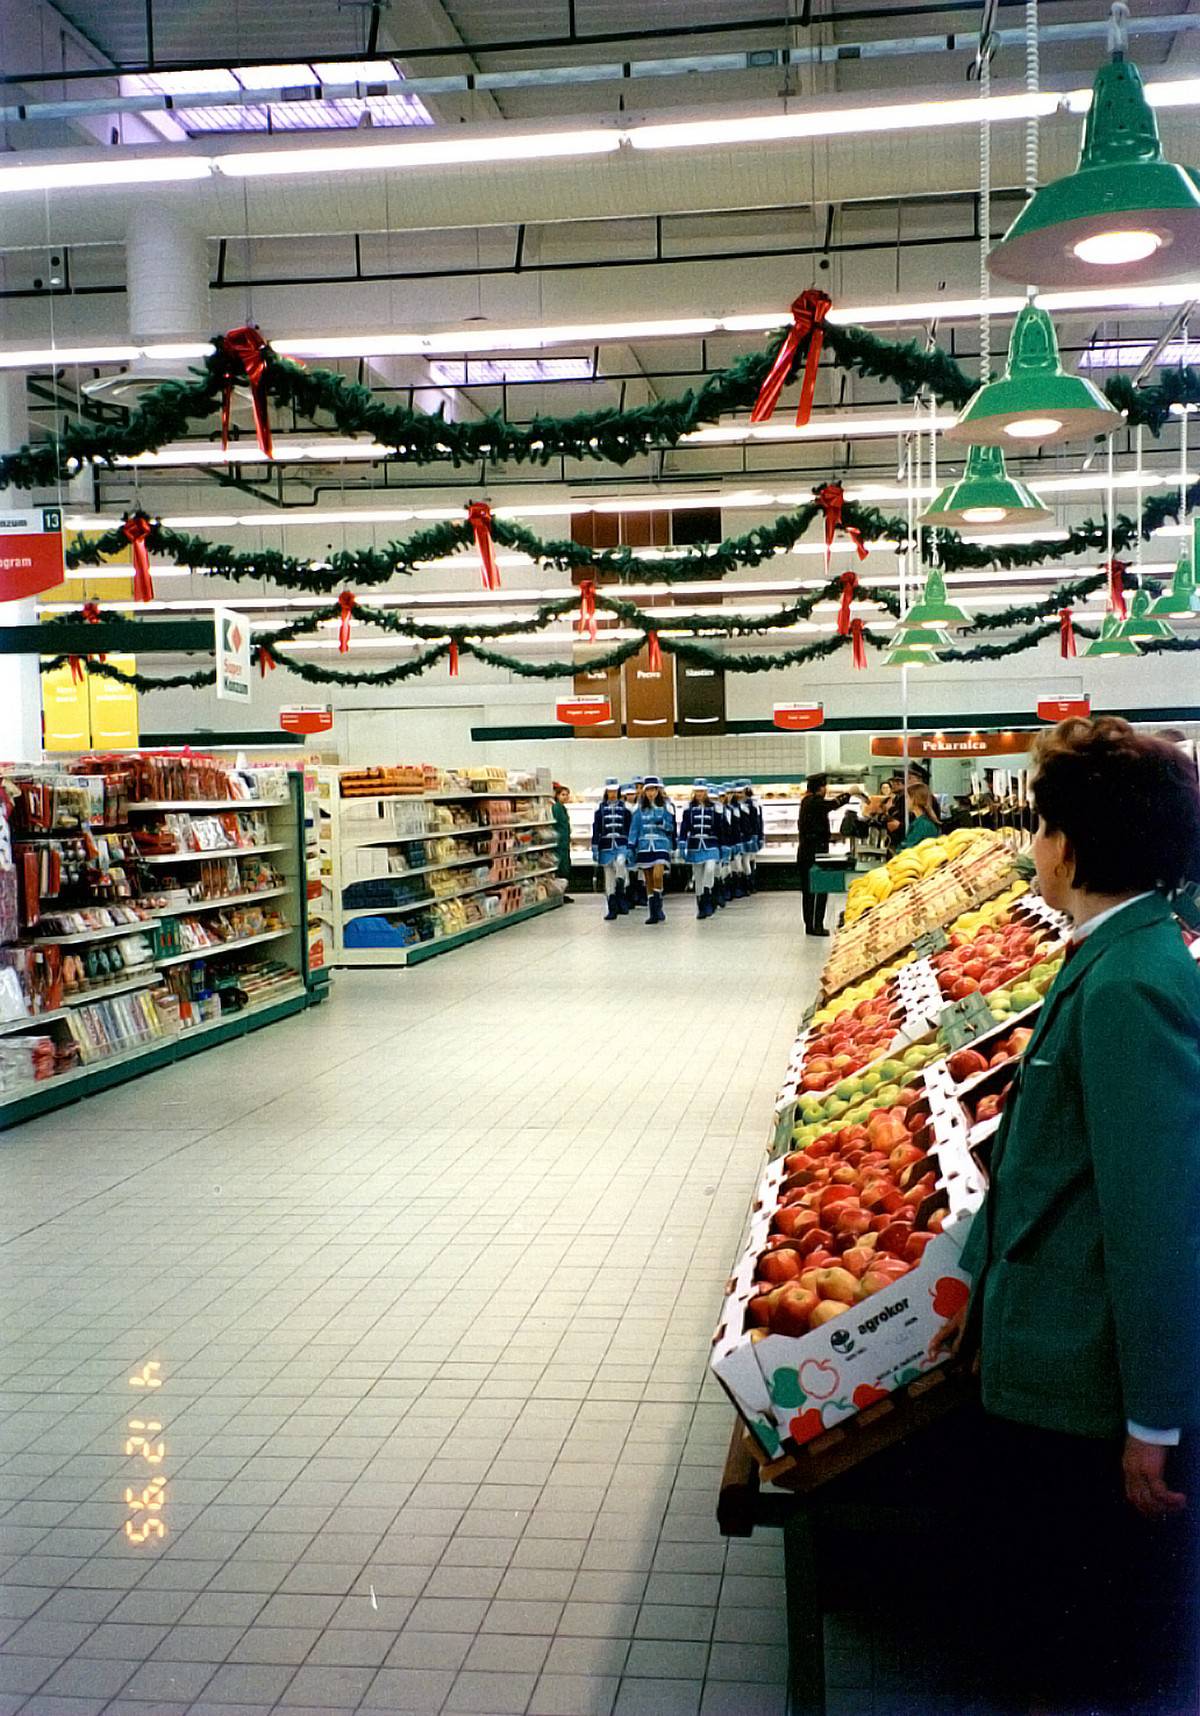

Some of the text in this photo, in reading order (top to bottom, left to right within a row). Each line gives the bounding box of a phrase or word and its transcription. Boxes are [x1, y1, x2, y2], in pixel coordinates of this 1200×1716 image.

[45, 513, 60, 528] 13
[922, 739, 987, 752] Pekarnica
[857, 1297, 910, 1336] agrokor
